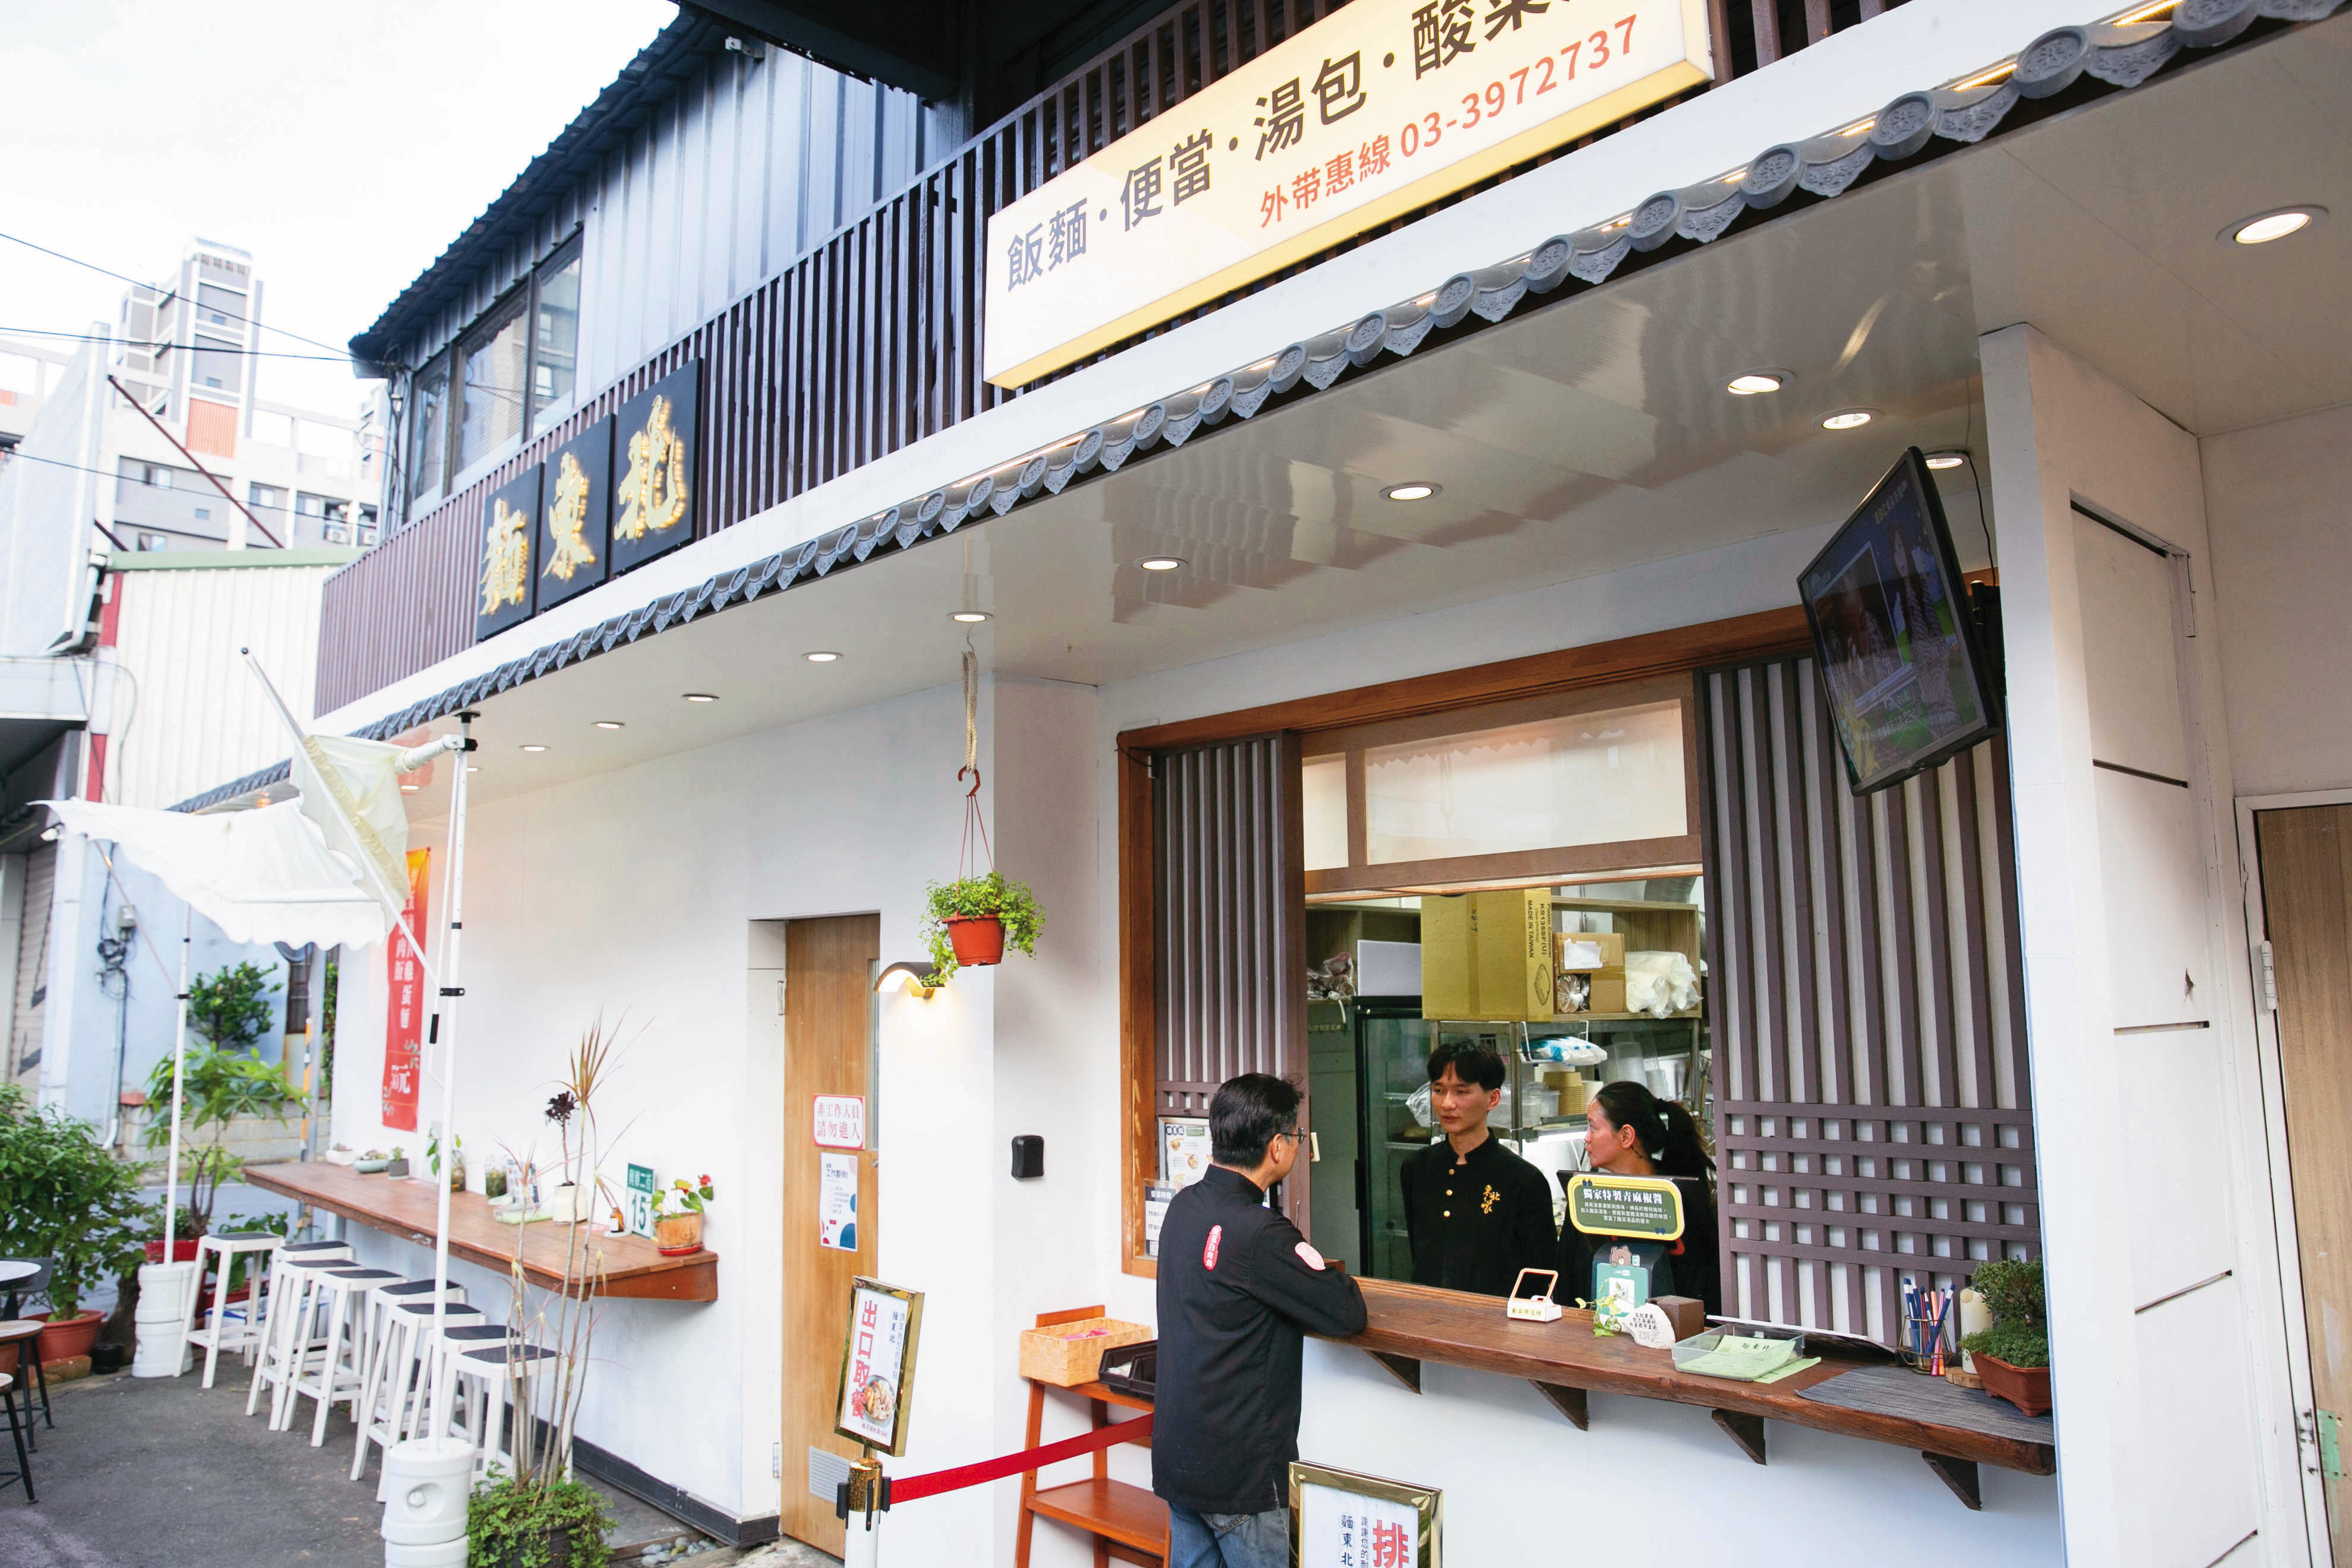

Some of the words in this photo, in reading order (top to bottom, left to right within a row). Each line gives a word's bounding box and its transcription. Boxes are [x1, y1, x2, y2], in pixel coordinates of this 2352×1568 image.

[1399, 14, 1637, 157] 03-3972737
[817, 1102, 860, 1120] 非工作人員
[817, 1120, 860, 1140] 請勿進入
[631, 1193, 646, 1230] 15
[851, 1300, 878, 1420] 出口取餐
[1341, 1514, 1354, 1567] 麵東北
[1373, 1519, 1409, 1568] 排
